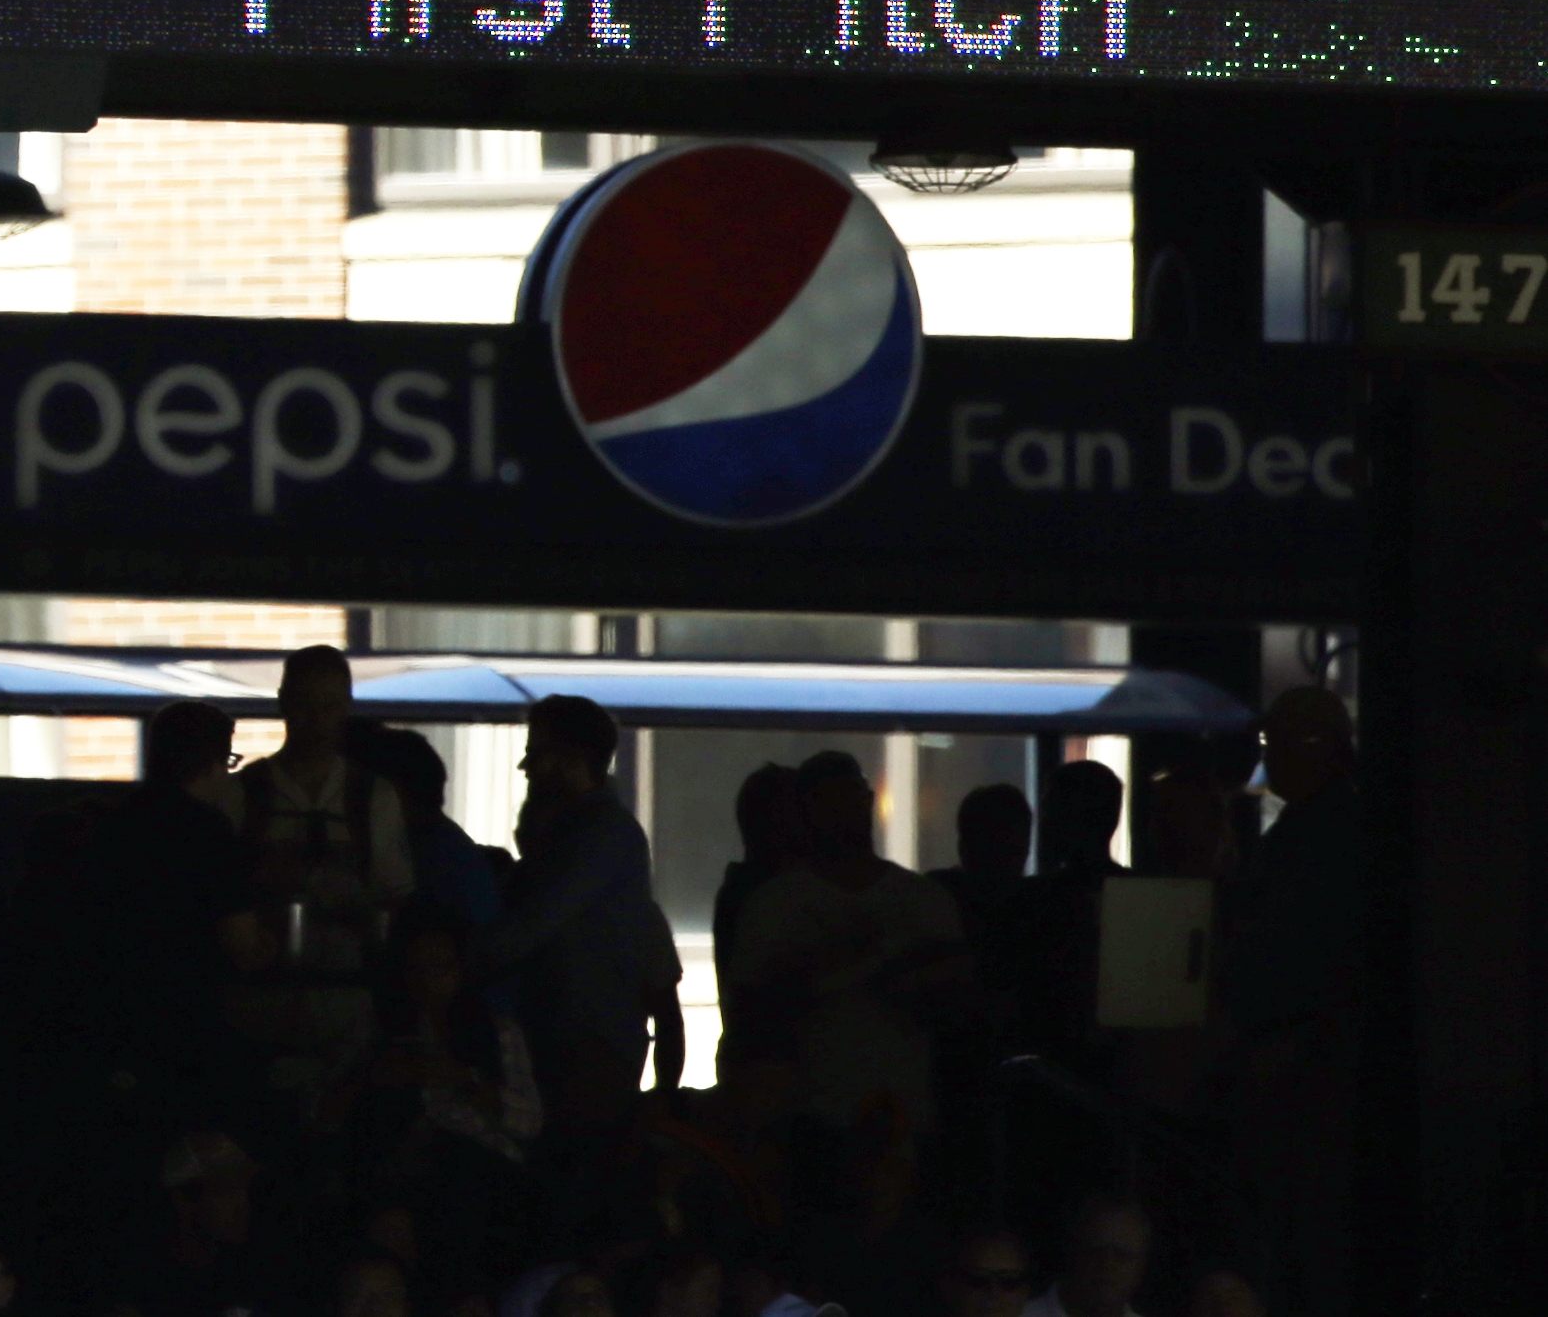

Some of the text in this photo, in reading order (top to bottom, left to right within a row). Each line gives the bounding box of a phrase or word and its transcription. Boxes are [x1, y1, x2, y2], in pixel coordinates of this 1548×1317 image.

[1396, 250, 1548, 325] 147
[14, 339, 498, 516] pepsi
[947, 402, 1357, 502] Fan Dec
